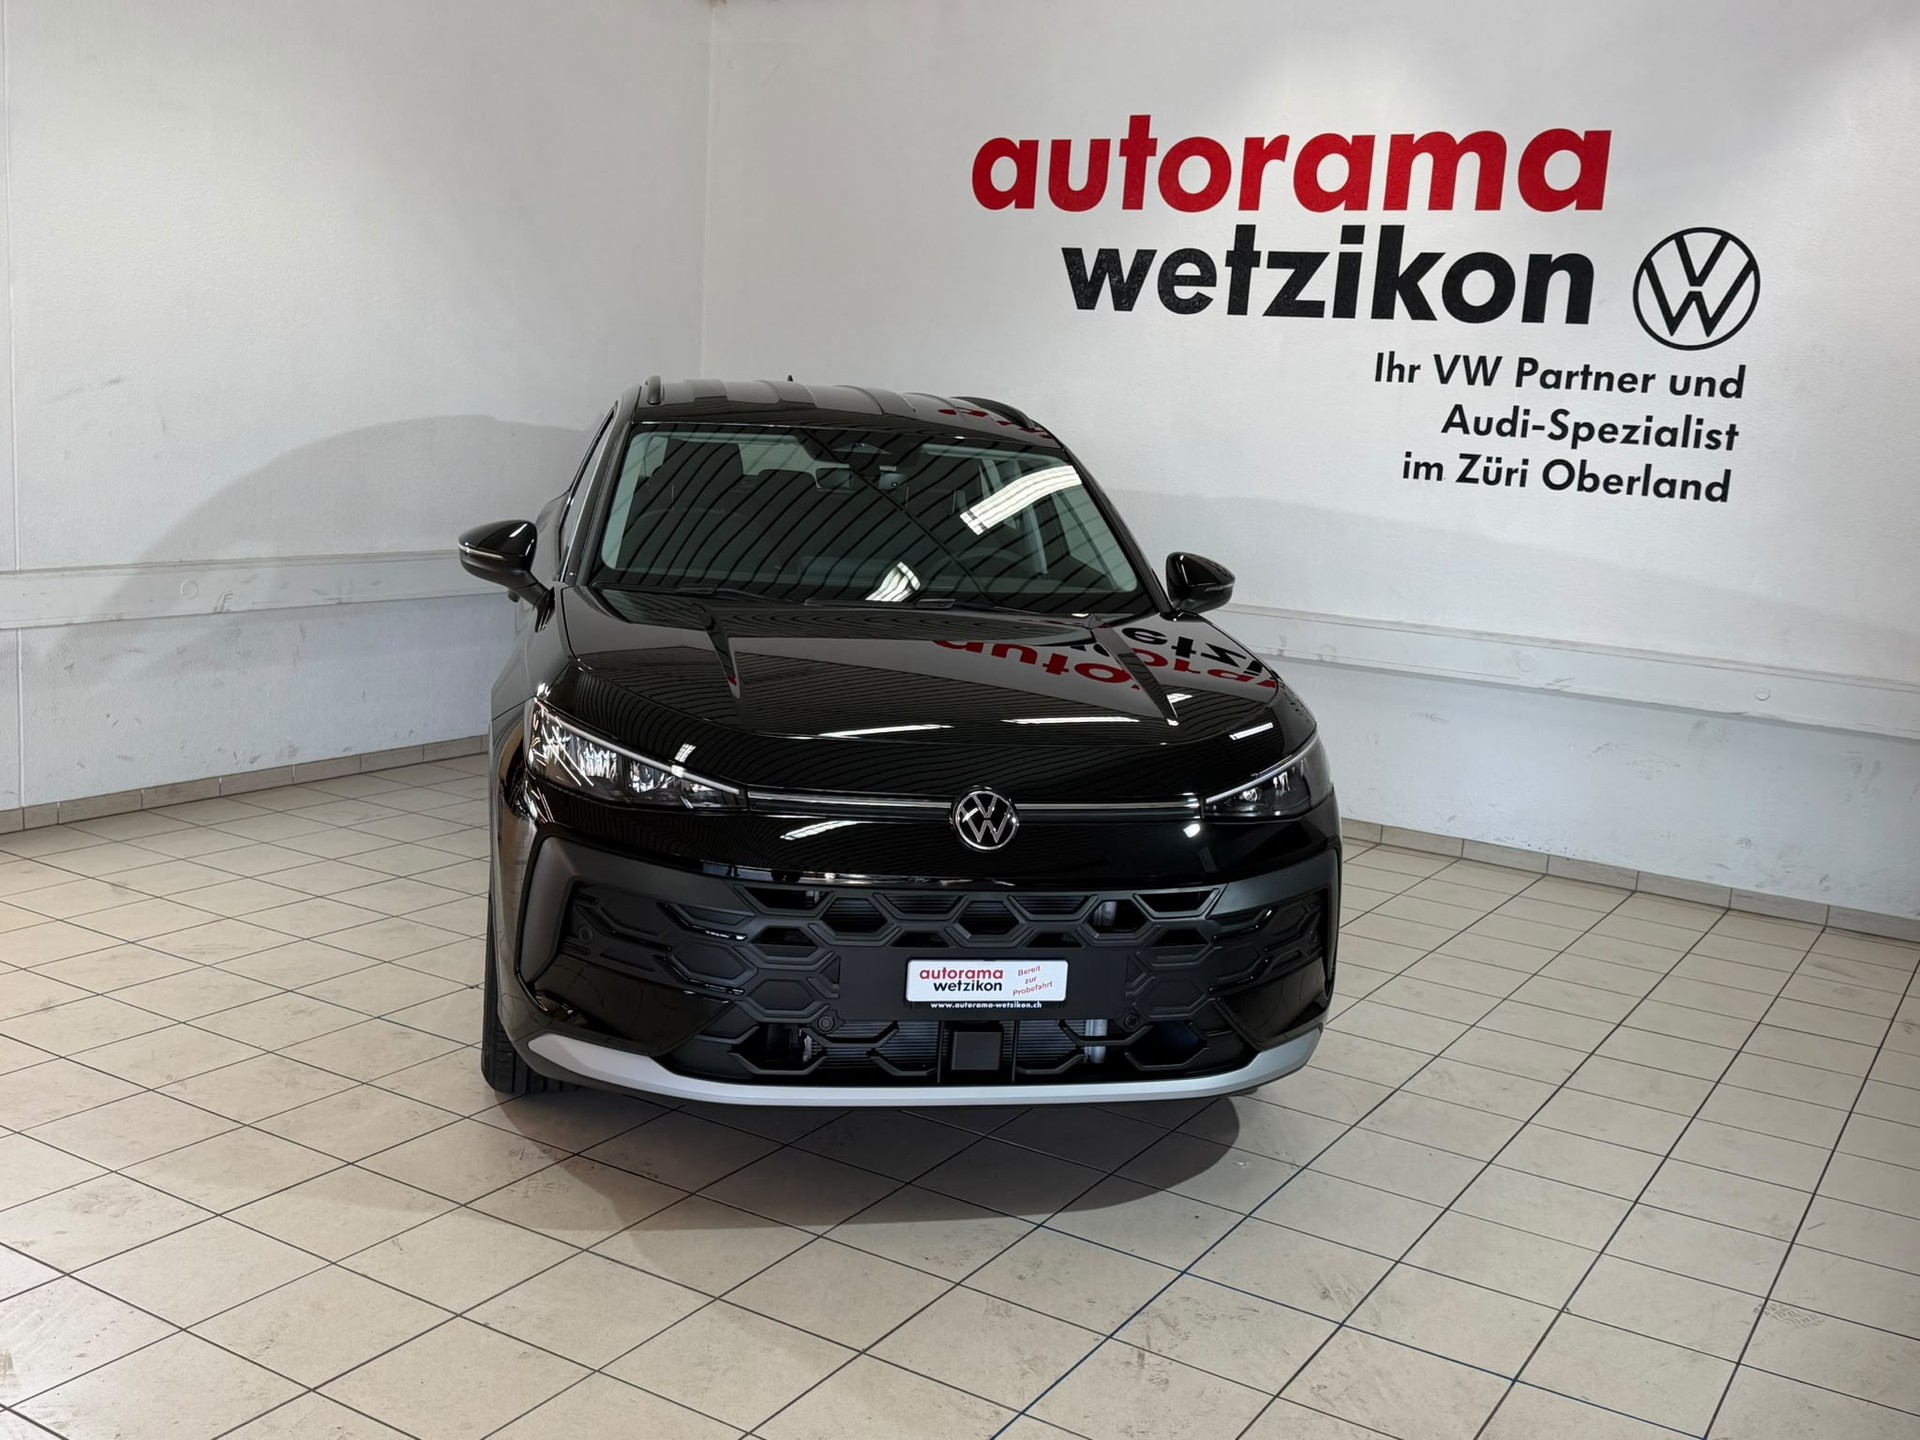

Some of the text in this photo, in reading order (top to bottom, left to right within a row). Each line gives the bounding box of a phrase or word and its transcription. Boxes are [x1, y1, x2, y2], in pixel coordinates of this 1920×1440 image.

[971, 114, 1612, 213] autorama
[1061, 224, 1595, 325] wetzikon
[1375, 351, 1747, 399] Ihr VW Partner und
[1441, 404, 1740, 451] Audi-Spezialist
[1402, 453, 1732, 503] im Züri Oberland
[919, 967, 1004, 980] autorama
[1017, 965, 1041, 977] Bereit
[933, 980, 1003, 992] wetzikon
[1024, 976, 1037, 984] zur
[1012, 981, 1053, 997] Probefahrt
[930, 1001, 1042, 1009] www.autorama-wetzikon.ch
